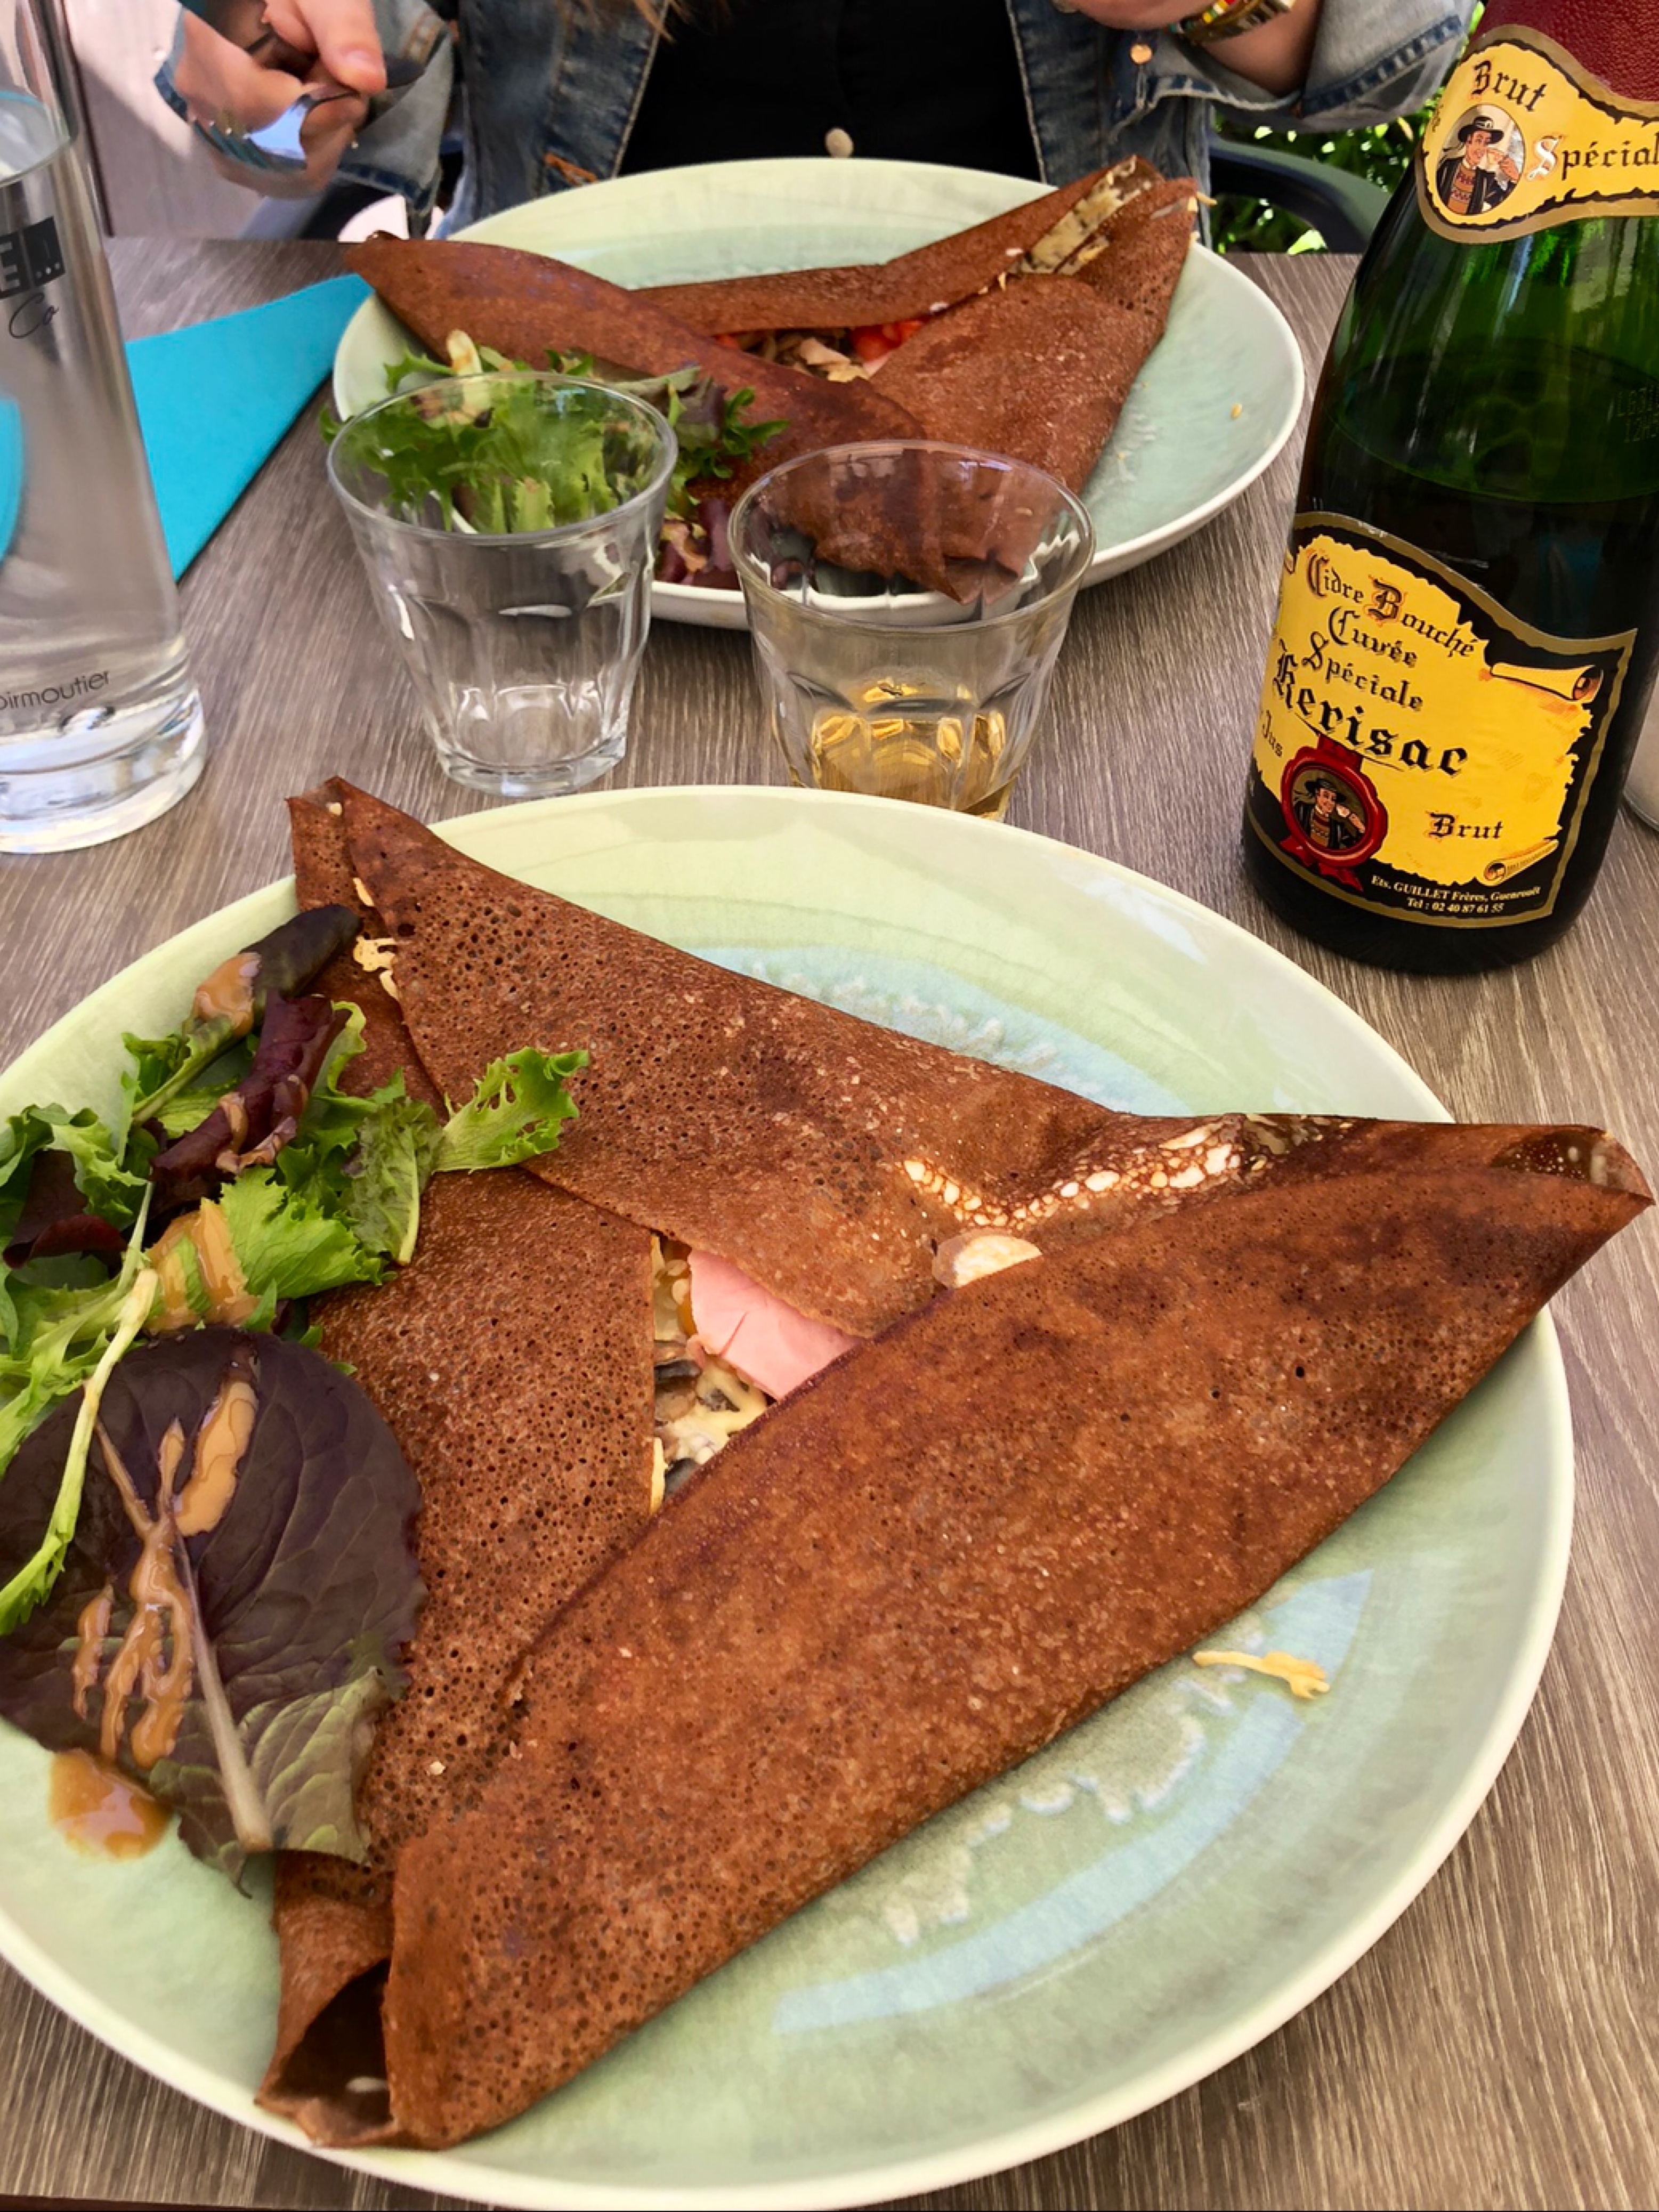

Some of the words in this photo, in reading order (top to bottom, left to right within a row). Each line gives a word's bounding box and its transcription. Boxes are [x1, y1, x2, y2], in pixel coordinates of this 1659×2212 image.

[1471, 60, 1547, 112] Brut
[1306, 553, 1365, 604] Cidre
[1365, 576, 1475, 659] Bouché
[1328, 605, 1418, 668] Cuvée
[1301, 631, 1424, 712] Spéciale
[1273, 638, 1469, 776] Kerisac
[1429, 811, 1503, 839] Brut
[1393, 882, 1451, 900] GUILLET
[1431, 902, 1446, 911] 02
[1446, 904, 1461, 912] 40
